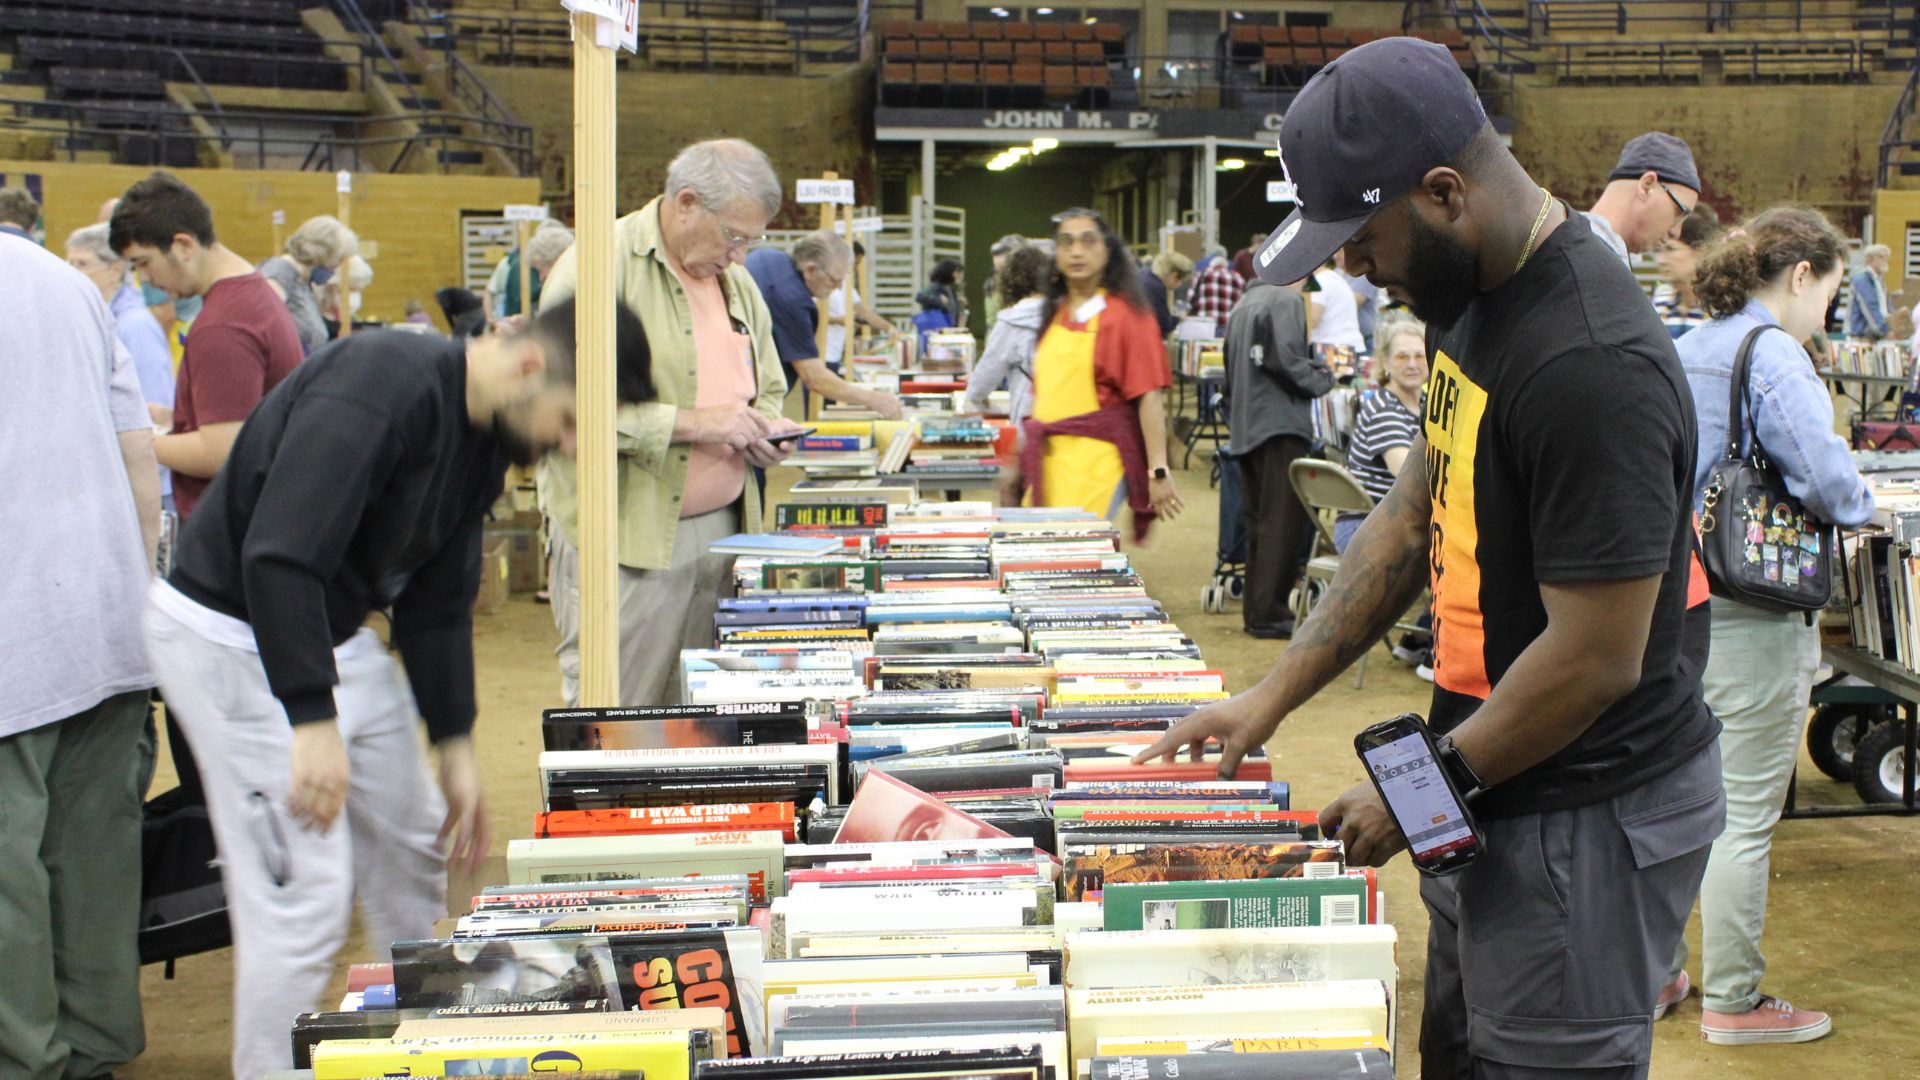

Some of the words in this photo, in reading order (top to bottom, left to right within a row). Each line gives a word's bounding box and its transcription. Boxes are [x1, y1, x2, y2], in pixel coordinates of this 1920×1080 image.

[983, 111, 1063, 129] JOHN
[1077, 112, 1112, 129] M.
[1085, 698, 1133, 706] BATTLE
[715, 703, 781, 714] FIGHTERS
[742, 730, 754, 745] THE
[749, 746, 782, 755] GREAT
[629, 807, 646, 819] II
[648, 805, 688, 818] WAR
[689, 803, 751, 816] WORLD
[650, 817, 664, 825] OF
[664, 816, 704, 824] STORIES
[705, 814, 731, 823] TRUE
[647, 875, 692, 883] Patton
[509, 892, 539, 901] WAR
[539, 891, 590, 900] ENIGMA
[591, 890, 614, 898] THE
[512, 898, 589, 908] WILLIAM
[1087, 996, 1142, 1004] ALBERT
[472, 1004, 537, 1013] AIRMEN
[537, 1001, 571, 1011] THE
[435, 1007, 470, 1016] WHO
[605, 1016, 667, 1024] COMMAND
[1241, 1039, 1320, 1053] PARIS
[710, 1057, 766, 1067] Nelson
[771, 1056, 791, 1064] The
[795, 1055, 818, 1065] Life
[819, 1053, 842, 1062] and
[844, 1052, 881, 1061] Letters
[883, 1051, 896, 1060] of
[911, 1048, 941, 1057] Hero
[1107, 1062, 1120, 1078] THE
